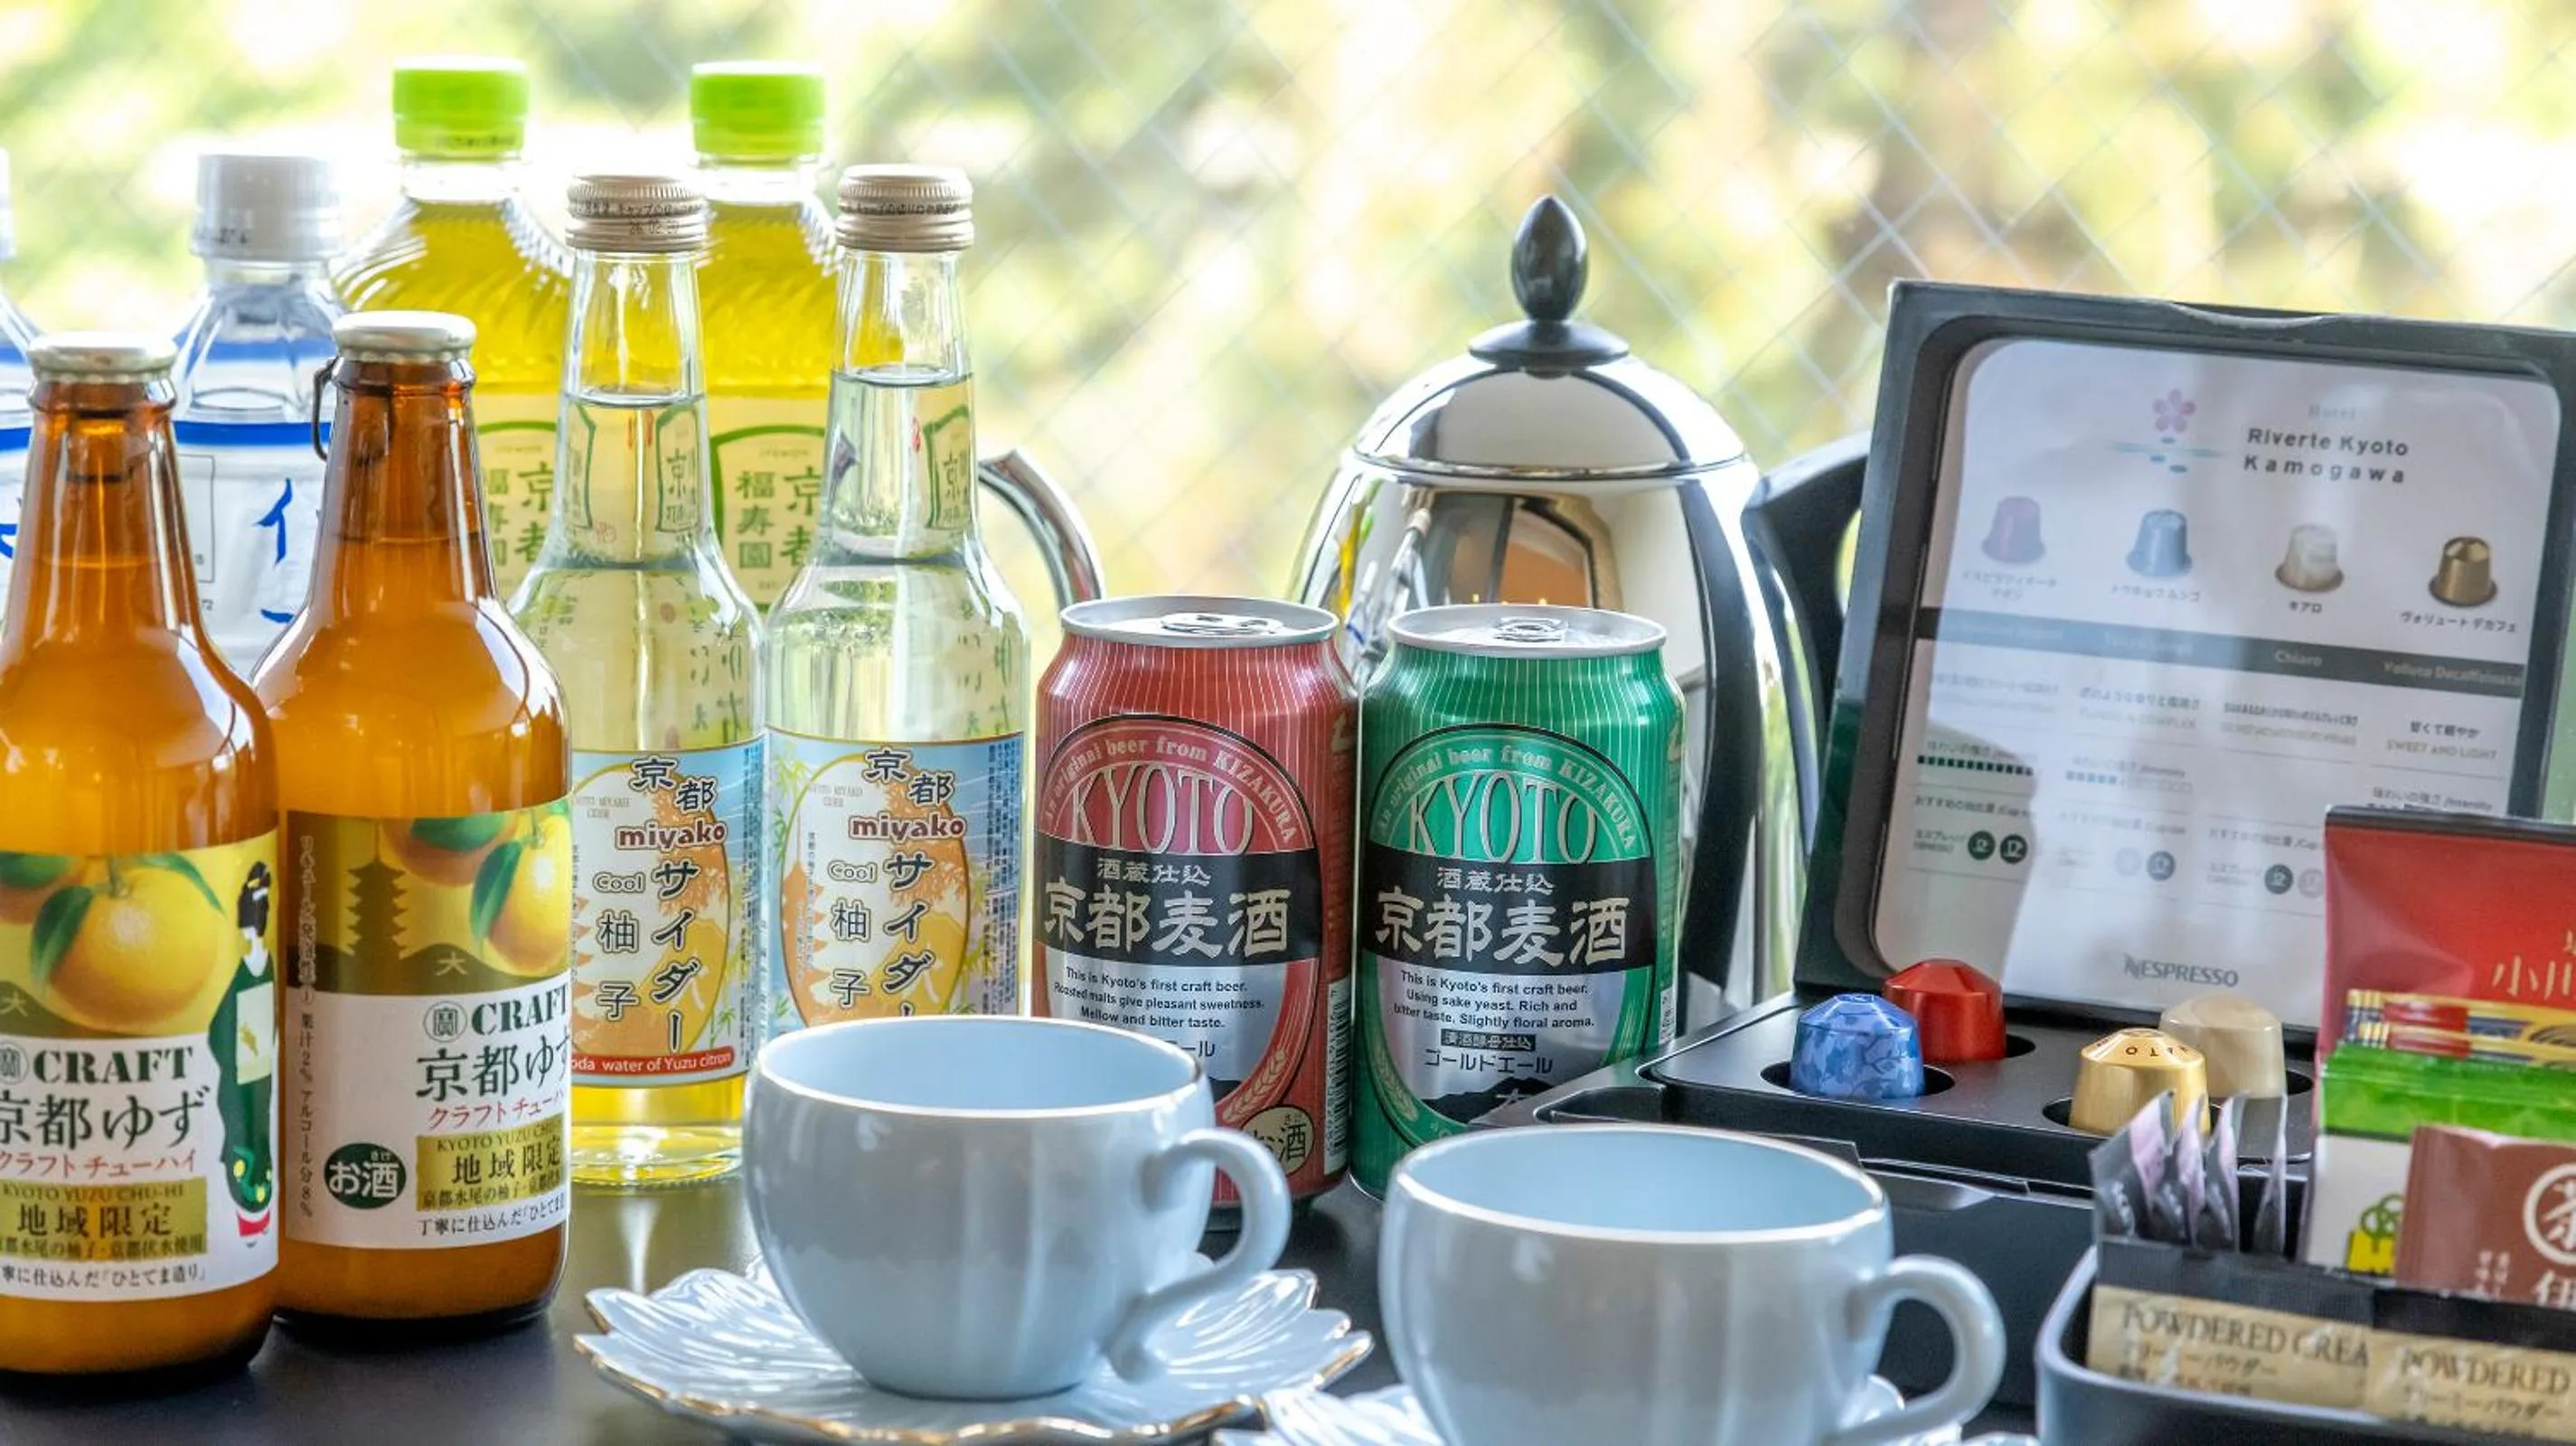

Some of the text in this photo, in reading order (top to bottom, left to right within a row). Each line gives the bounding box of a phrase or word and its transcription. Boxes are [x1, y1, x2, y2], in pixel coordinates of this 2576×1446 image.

[2247, 427, 2409, 456] Riverte Kyoto
[2243, 455, 2405, 484] Kamogawa
[628, 755, 717, 814] 京都
[861, 746, 956, 808] 京都
[1105, 737, 1149, 758] beer
[1155, 736, 1208, 763] from
[1212, 749, 1297, 843] KIZAKURA
[1068, 762, 1255, 857] KYOTO
[1389, 750, 1444, 806] original
[1448, 747, 1492, 765] beer
[1500, 745, 1553, 769] from
[1557, 757, 1637, 849] KIZAKURA
[616, 819, 727, 852] miyako
[849, 812, 967, 844] miyako
[1406, 771, 1598, 865] KYOTO
[593, 871, 645, 893] Cool
[827, 859, 878, 882] Cool
[1096, 857, 1212, 888] 酒蔵仕込
[1436, 867, 1556, 897] 酒蔵仕込
[1043, 875, 1293, 958] 京都麦酒
[1374, 884, 1631, 967] 京都麦酒
[595, 909, 640, 1022] 柚子
[649, 859, 701, 1056] サイダー
[829, 897, 871, 1009] 柚子
[2122, 952, 2240, 989] NESPRESSO
[1054, 981, 1265, 1011] Roasted malts give pleasant sweetness.
[1066, 966, 1248, 993] This is Kyoto's first craft beer.
[1401, 969, 1588, 995] This is Kyoto's first craft beer.
[472, 983, 568, 1036] CRAFT
[1080, 1004, 1226, 1028] Mellow and bitter taste.
[1394, 1002, 1594, 1030] bitter taste. Slightly floral aroma.
[1406, 989, 1577, 1012] Using sake yeast. Rich and
[33, 1046, 193, 1084] CRAFT
[603, 1060, 643, 1073] water
[646, 1057, 663, 1071] of
[664, 1057, 697, 1071] Yuzu
[699, 1051, 732, 1068] citron
[1424, 1047, 1554, 1075] ゴールドエール
[0, 1084, 211, 1151] 京都ゆず
[437, 1134, 494, 1152] KYOTO
[452, 1134, 561, 1185] 地域限定
[3, 1182, 60, 1200] KYOTO
[64, 1185, 112, 1203] YUZU
[329, 1160, 400, 1197] お酒
[17, 1201, 173, 1239] 地域限定
[2124, 1301, 2289, 1355] POWDERED
[2401, 1347, 2571, 1396] POWDERED
